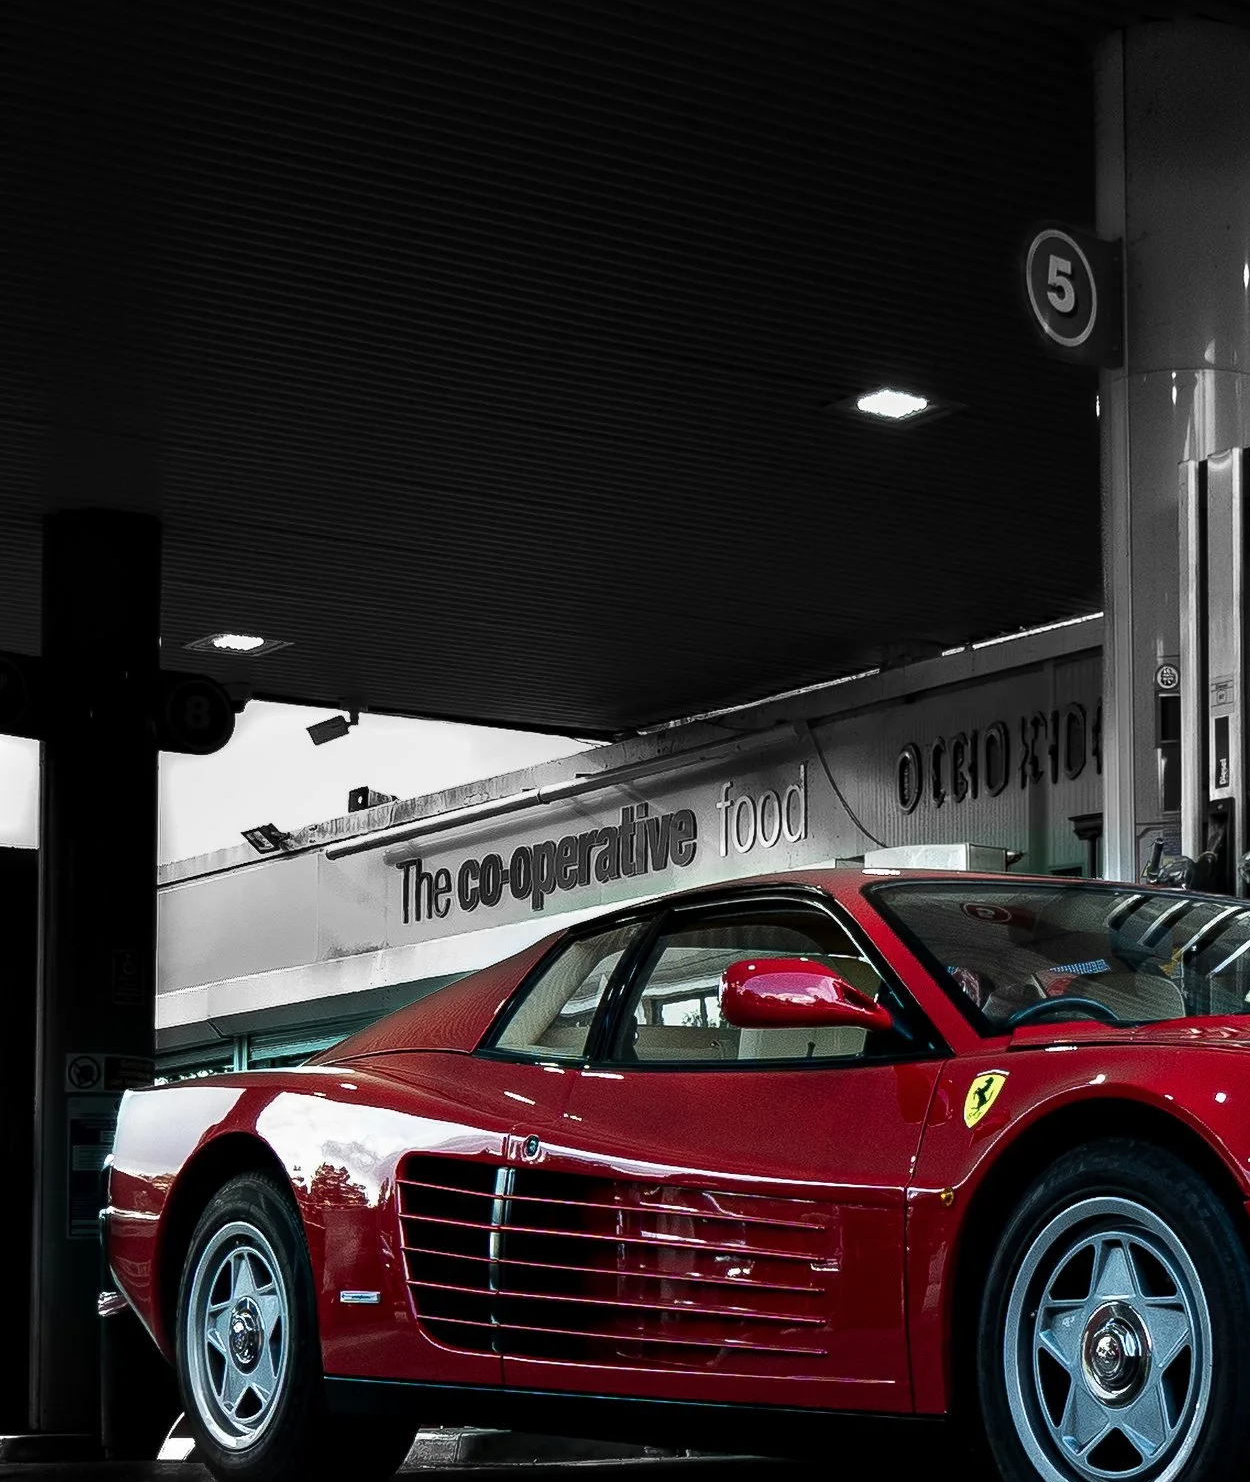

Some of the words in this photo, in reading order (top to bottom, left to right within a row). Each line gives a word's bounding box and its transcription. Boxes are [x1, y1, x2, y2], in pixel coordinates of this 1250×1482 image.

[1046, 254, 1076, 314] 5
[184, 695, 212, 730] 8
[395, 858, 454, 925] The
[457, 803, 698, 911] co-operative
[715, 763, 811, 858] food
